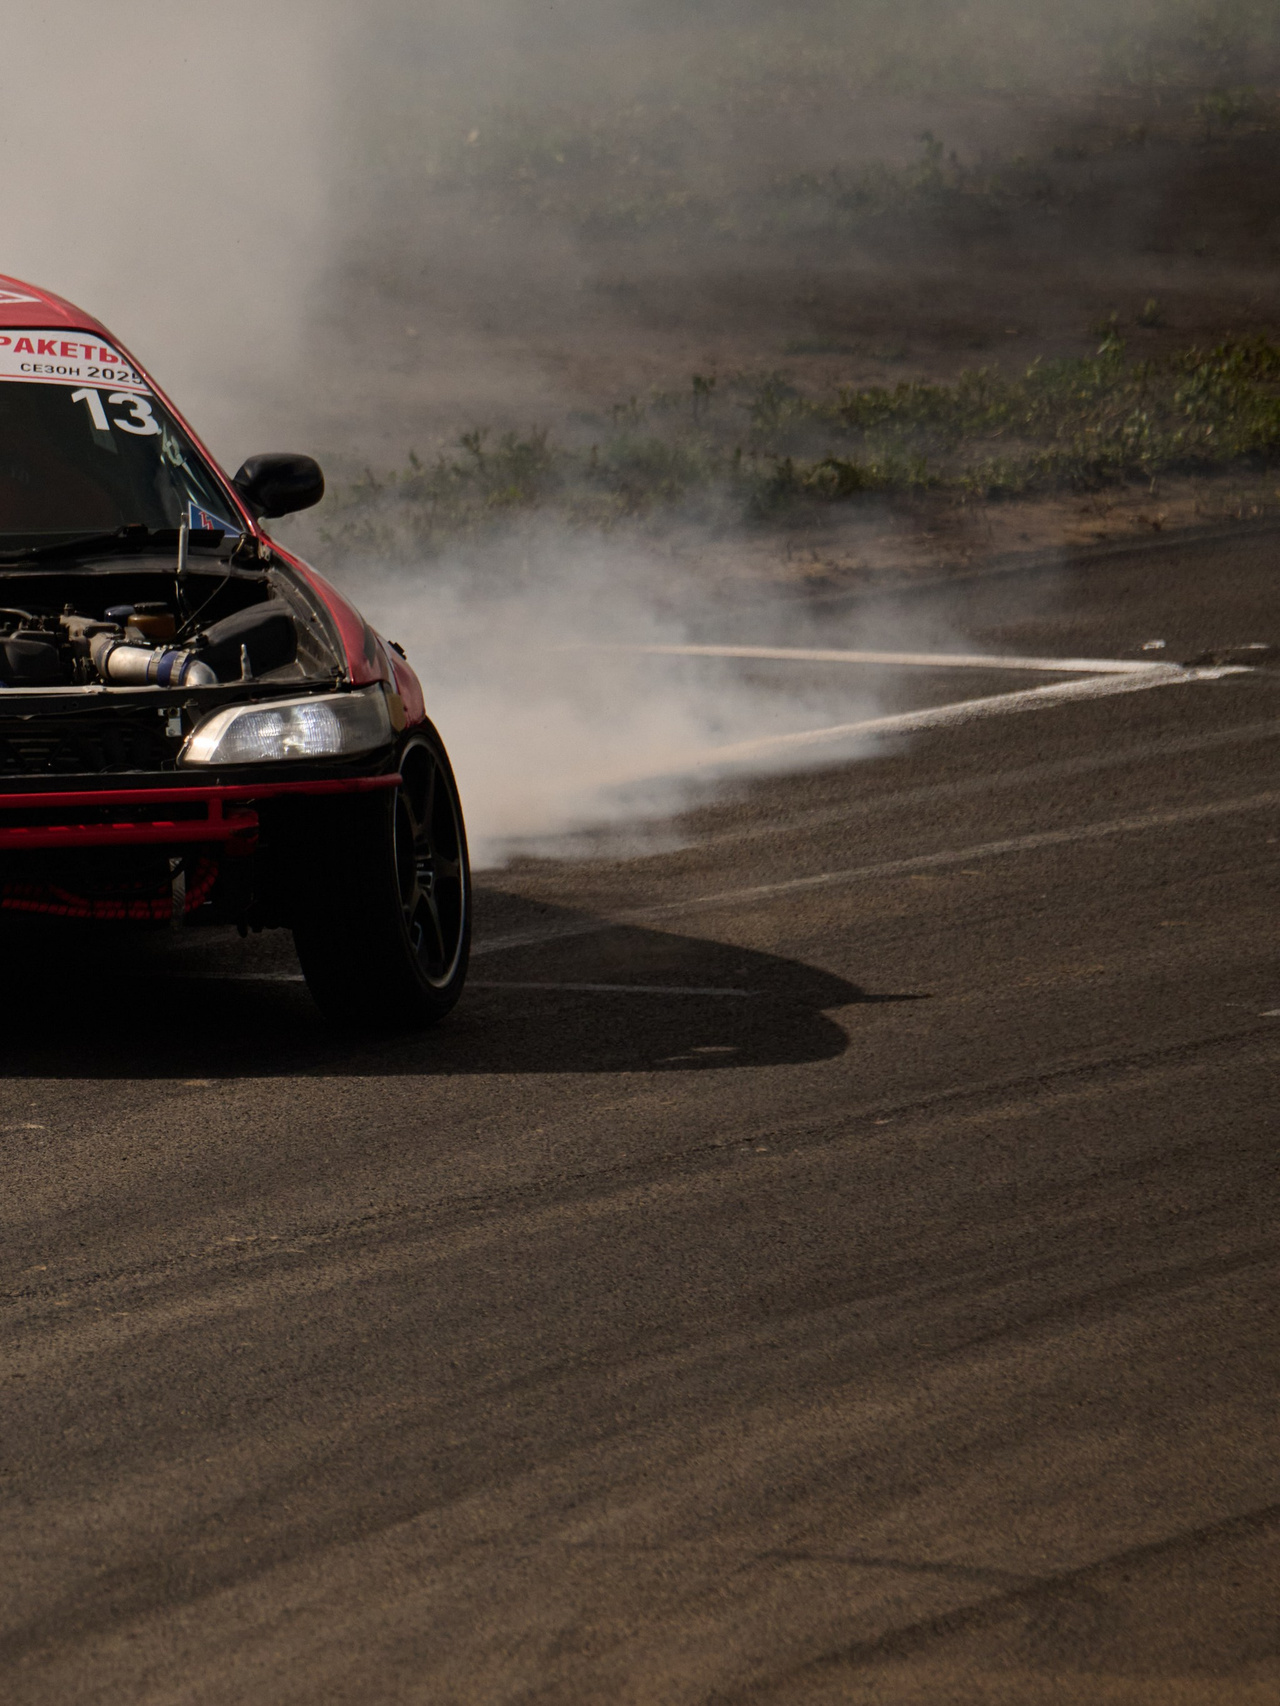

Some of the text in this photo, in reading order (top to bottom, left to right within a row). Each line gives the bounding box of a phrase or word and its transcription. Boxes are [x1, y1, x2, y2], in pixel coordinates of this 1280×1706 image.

[20, 363, 80, 376] СЕЗОН
[87, 366, 143, 384] 2025
[71, 388, 160, 436] 13
